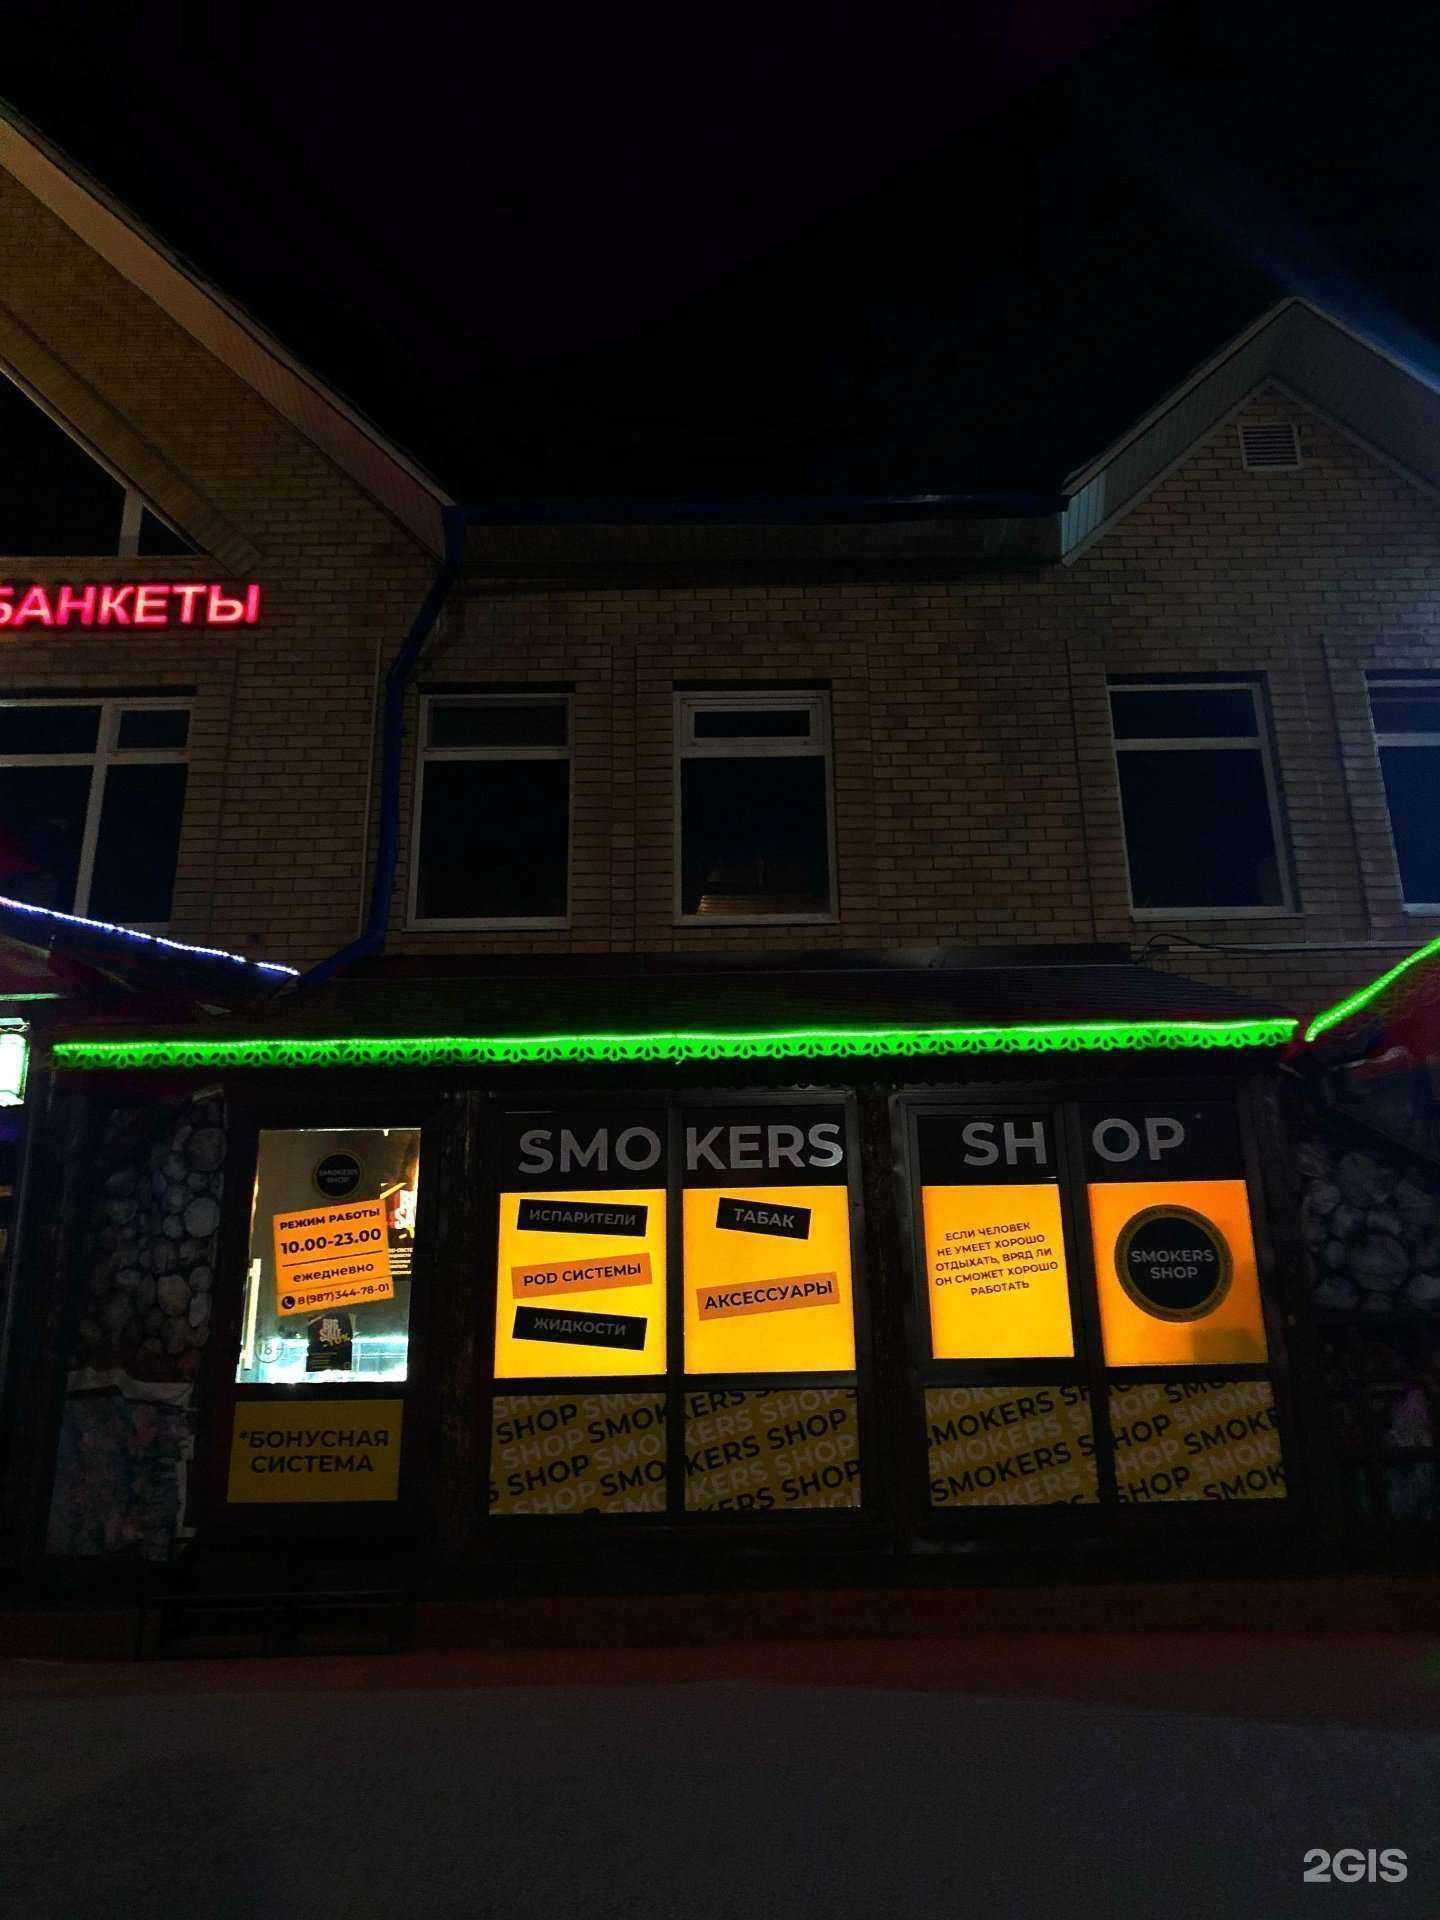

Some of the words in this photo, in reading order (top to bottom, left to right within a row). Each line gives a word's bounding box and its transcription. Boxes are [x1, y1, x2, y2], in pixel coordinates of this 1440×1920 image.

[280, 1216, 326, 1230] РЕЖИМ
[329, 1208, 380, 1223] РАБОТЫ
[529, 1208, 637, 1227] ИСПАРИТЕЛИ
[733, 1208, 795, 1229] ТАБАК
[280, 1228, 381, 1255] 10.00-23.00
[945, 1230, 976, 1241] ЕСЛИ
[977, 1222, 1031, 1236] ЧЕЛОВЕК
[937, 1247, 952, 1257] НЕ
[955, 1241, 992, 1254] УМЕЕТ
[994, 1234, 1045, 1249] ХОРОШО
[1002, 1250, 1034, 1262] ВРЯД
[1035, 1247, 1053, 1257] ЛИ
[1130, 1249, 1216, 1263] SMOKERS
[293, 1263, 375, 1283] ежедневно
[523, 1271, 558, 1287] POD
[562, 1262, 641, 1282] СИСТЕМЫ
[935, 1277, 953, 1286] ОН
[955, 1269, 1004, 1283] СМОЖЕТ
[1007, 1261, 1058, 1276] ХОРОШО
[1150, 1266, 1199, 1280] SHOP
[704, 1280, 833, 1311] АКСЕССУАРЫ
[970, 1280, 1030, 1296] РАБОТАТЬ
[534, 1317, 627, 1336] ЖИДКОСТИ
[496, 1404, 577, 1444] SHOP
[767, 1408, 847, 1450] SHOP
[251, 1455, 374, 1473] СИСТЕМА
[930, 1441, 1072, 1503] SMOKERS
[507, 1455, 589, 1496] SHOP
[782, 1459, 864, 1501] SHOP
